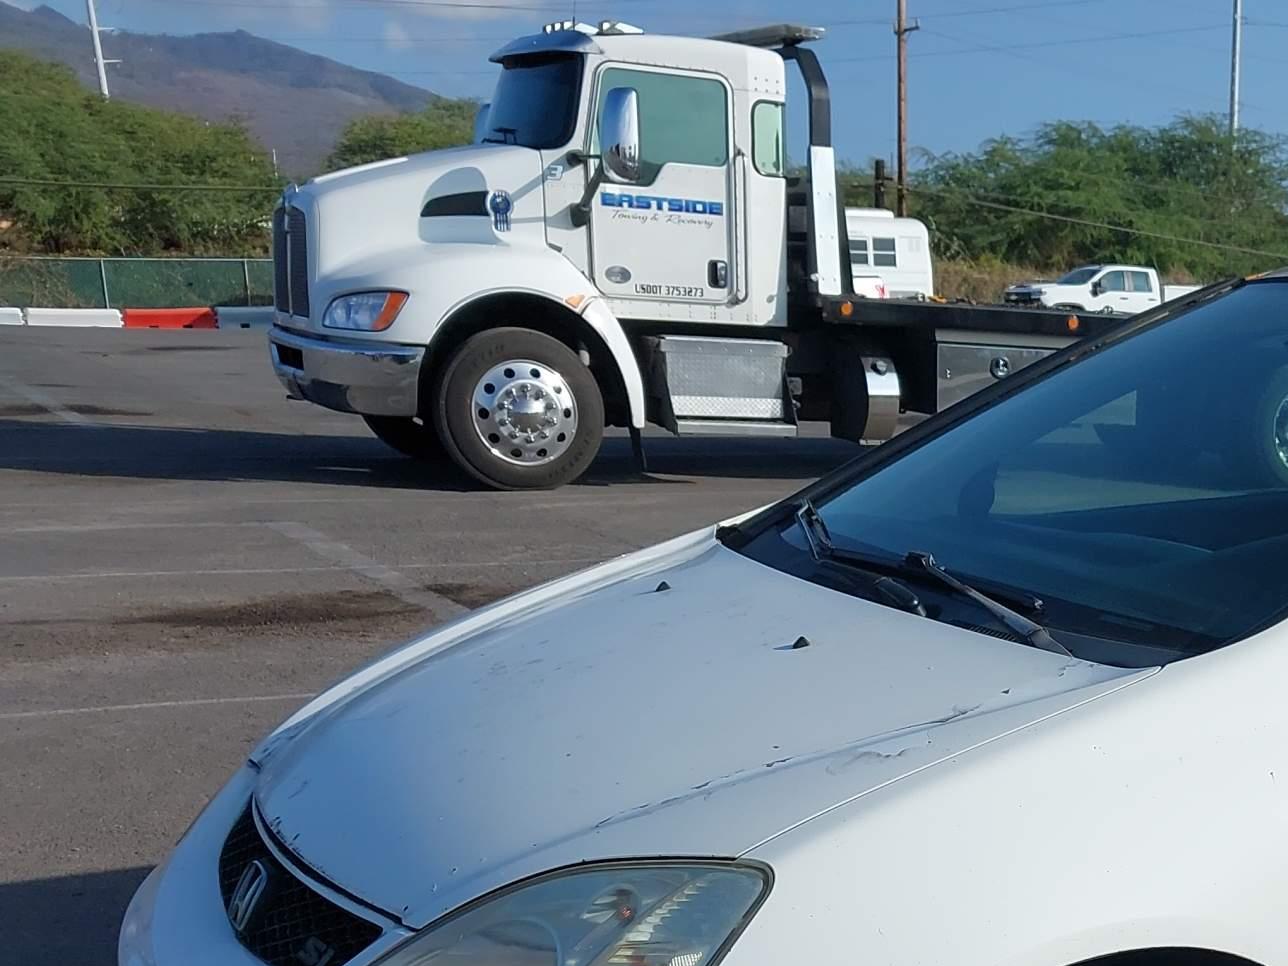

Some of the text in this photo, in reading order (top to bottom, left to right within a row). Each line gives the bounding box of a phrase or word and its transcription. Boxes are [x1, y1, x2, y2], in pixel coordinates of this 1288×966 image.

[601, 191, 723, 216] EASTSIDE
[611, 209, 713, 229] Towing & Recovery
[634, 283, 704, 297] USDOT 3753273
